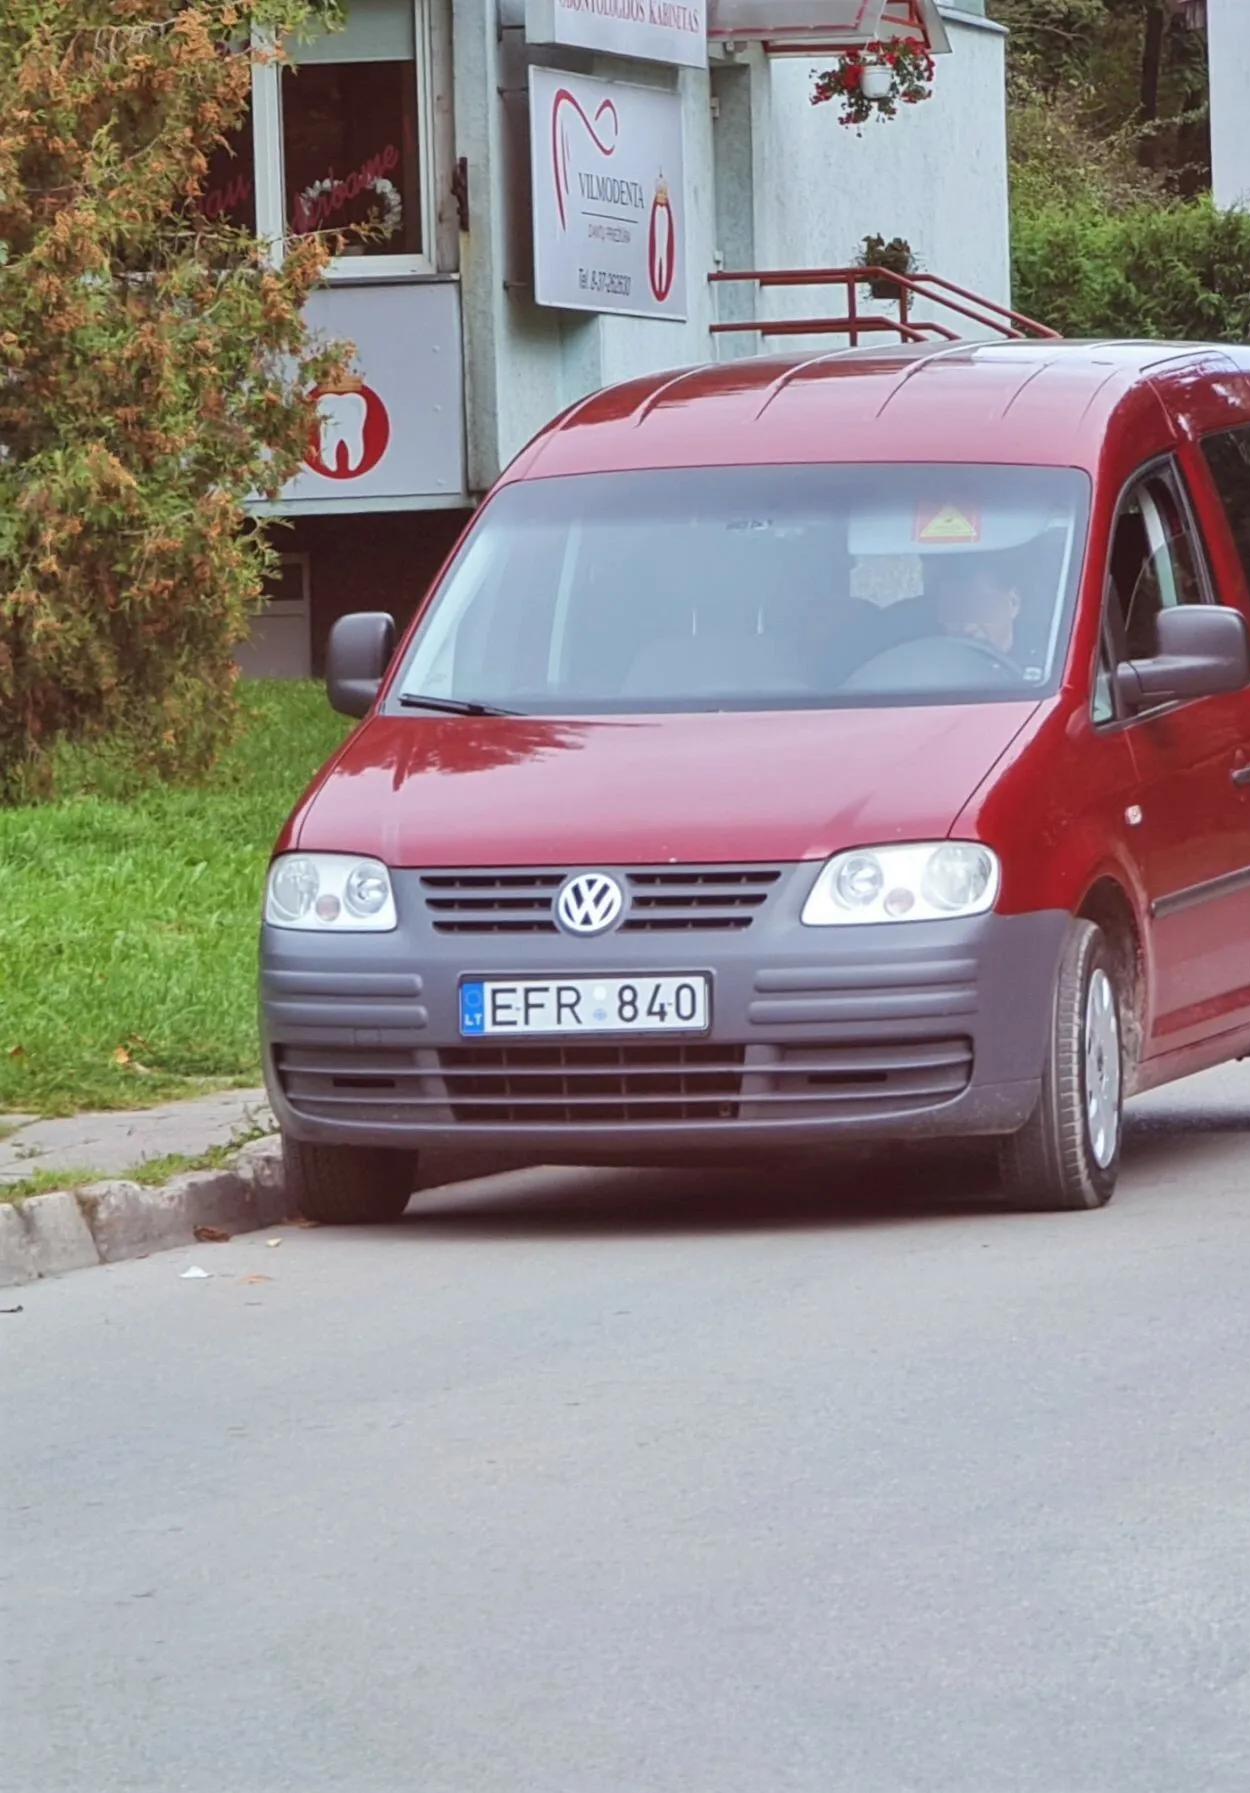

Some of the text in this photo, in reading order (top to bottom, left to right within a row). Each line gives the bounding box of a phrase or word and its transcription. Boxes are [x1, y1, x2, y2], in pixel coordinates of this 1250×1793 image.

[559, 0, 699, 33] NTOLOGIJOS KABINETAS
[578, 172, 645, 209] VILMODENTA
[464, 1013, 483, 1026] LT
[490, 983, 697, 1026] EFR 840
